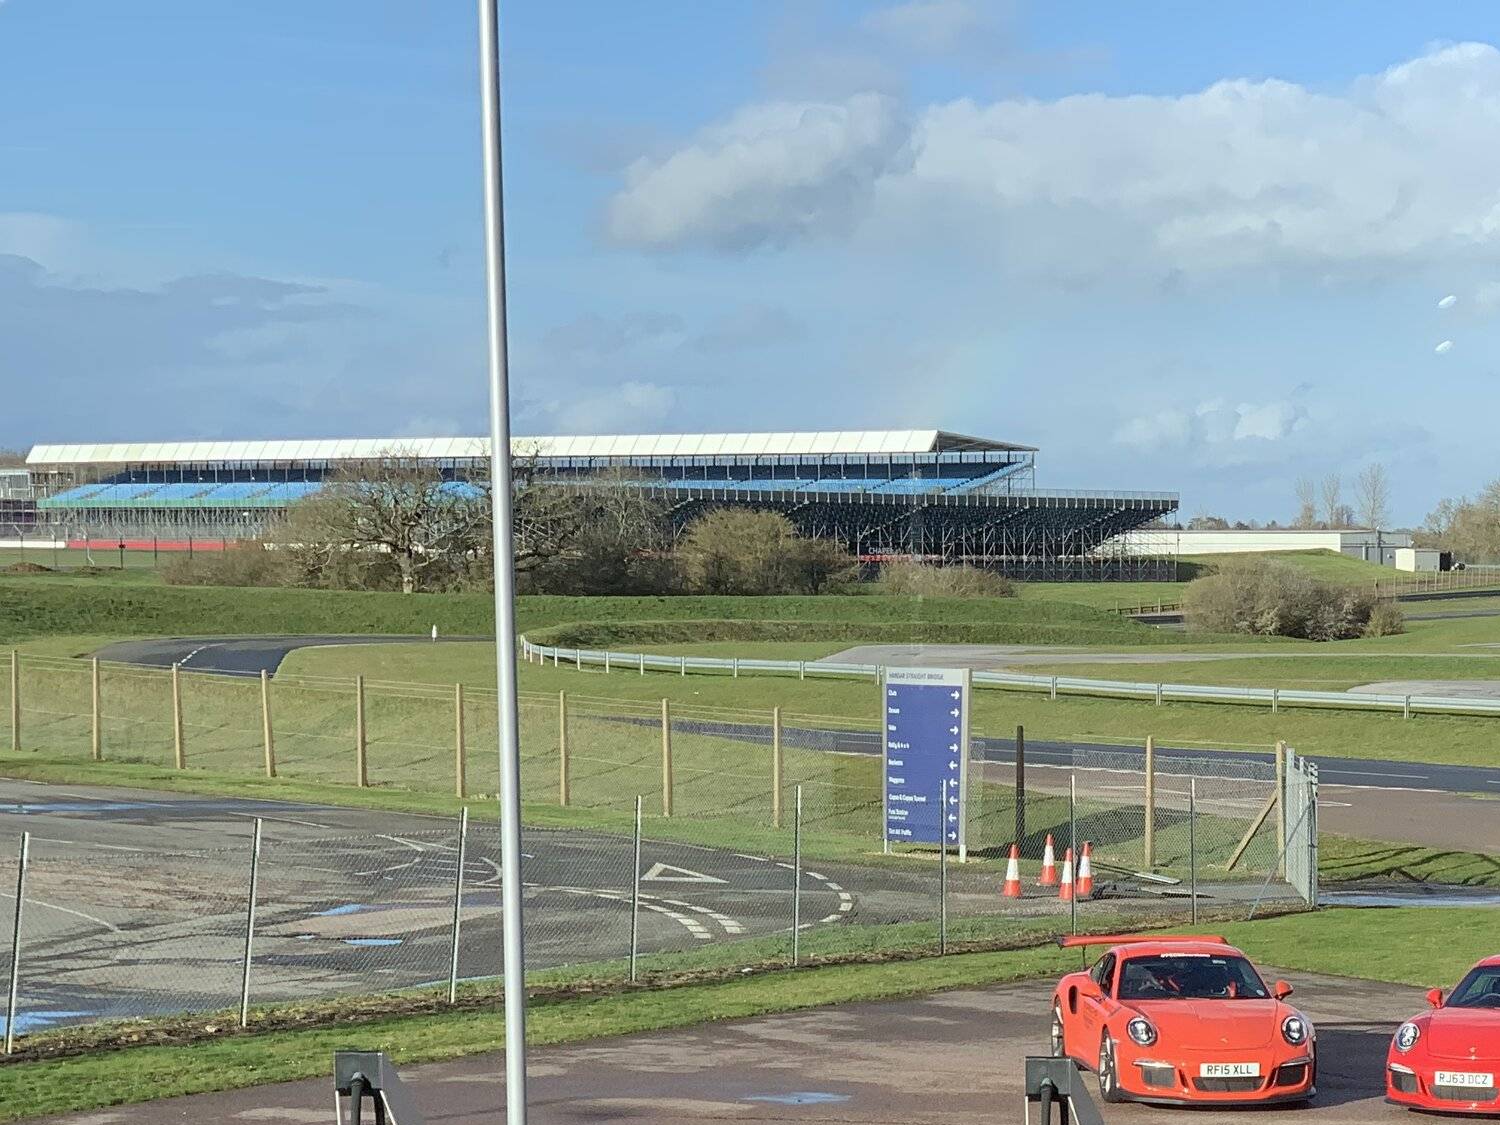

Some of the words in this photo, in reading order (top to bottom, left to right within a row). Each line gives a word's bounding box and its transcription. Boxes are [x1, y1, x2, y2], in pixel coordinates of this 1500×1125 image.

[1206, 1065, 1230, 1075] RF15
[1233, 1065, 1252, 1075] XLL
[1439, 1072, 1465, 1084] RJ63
